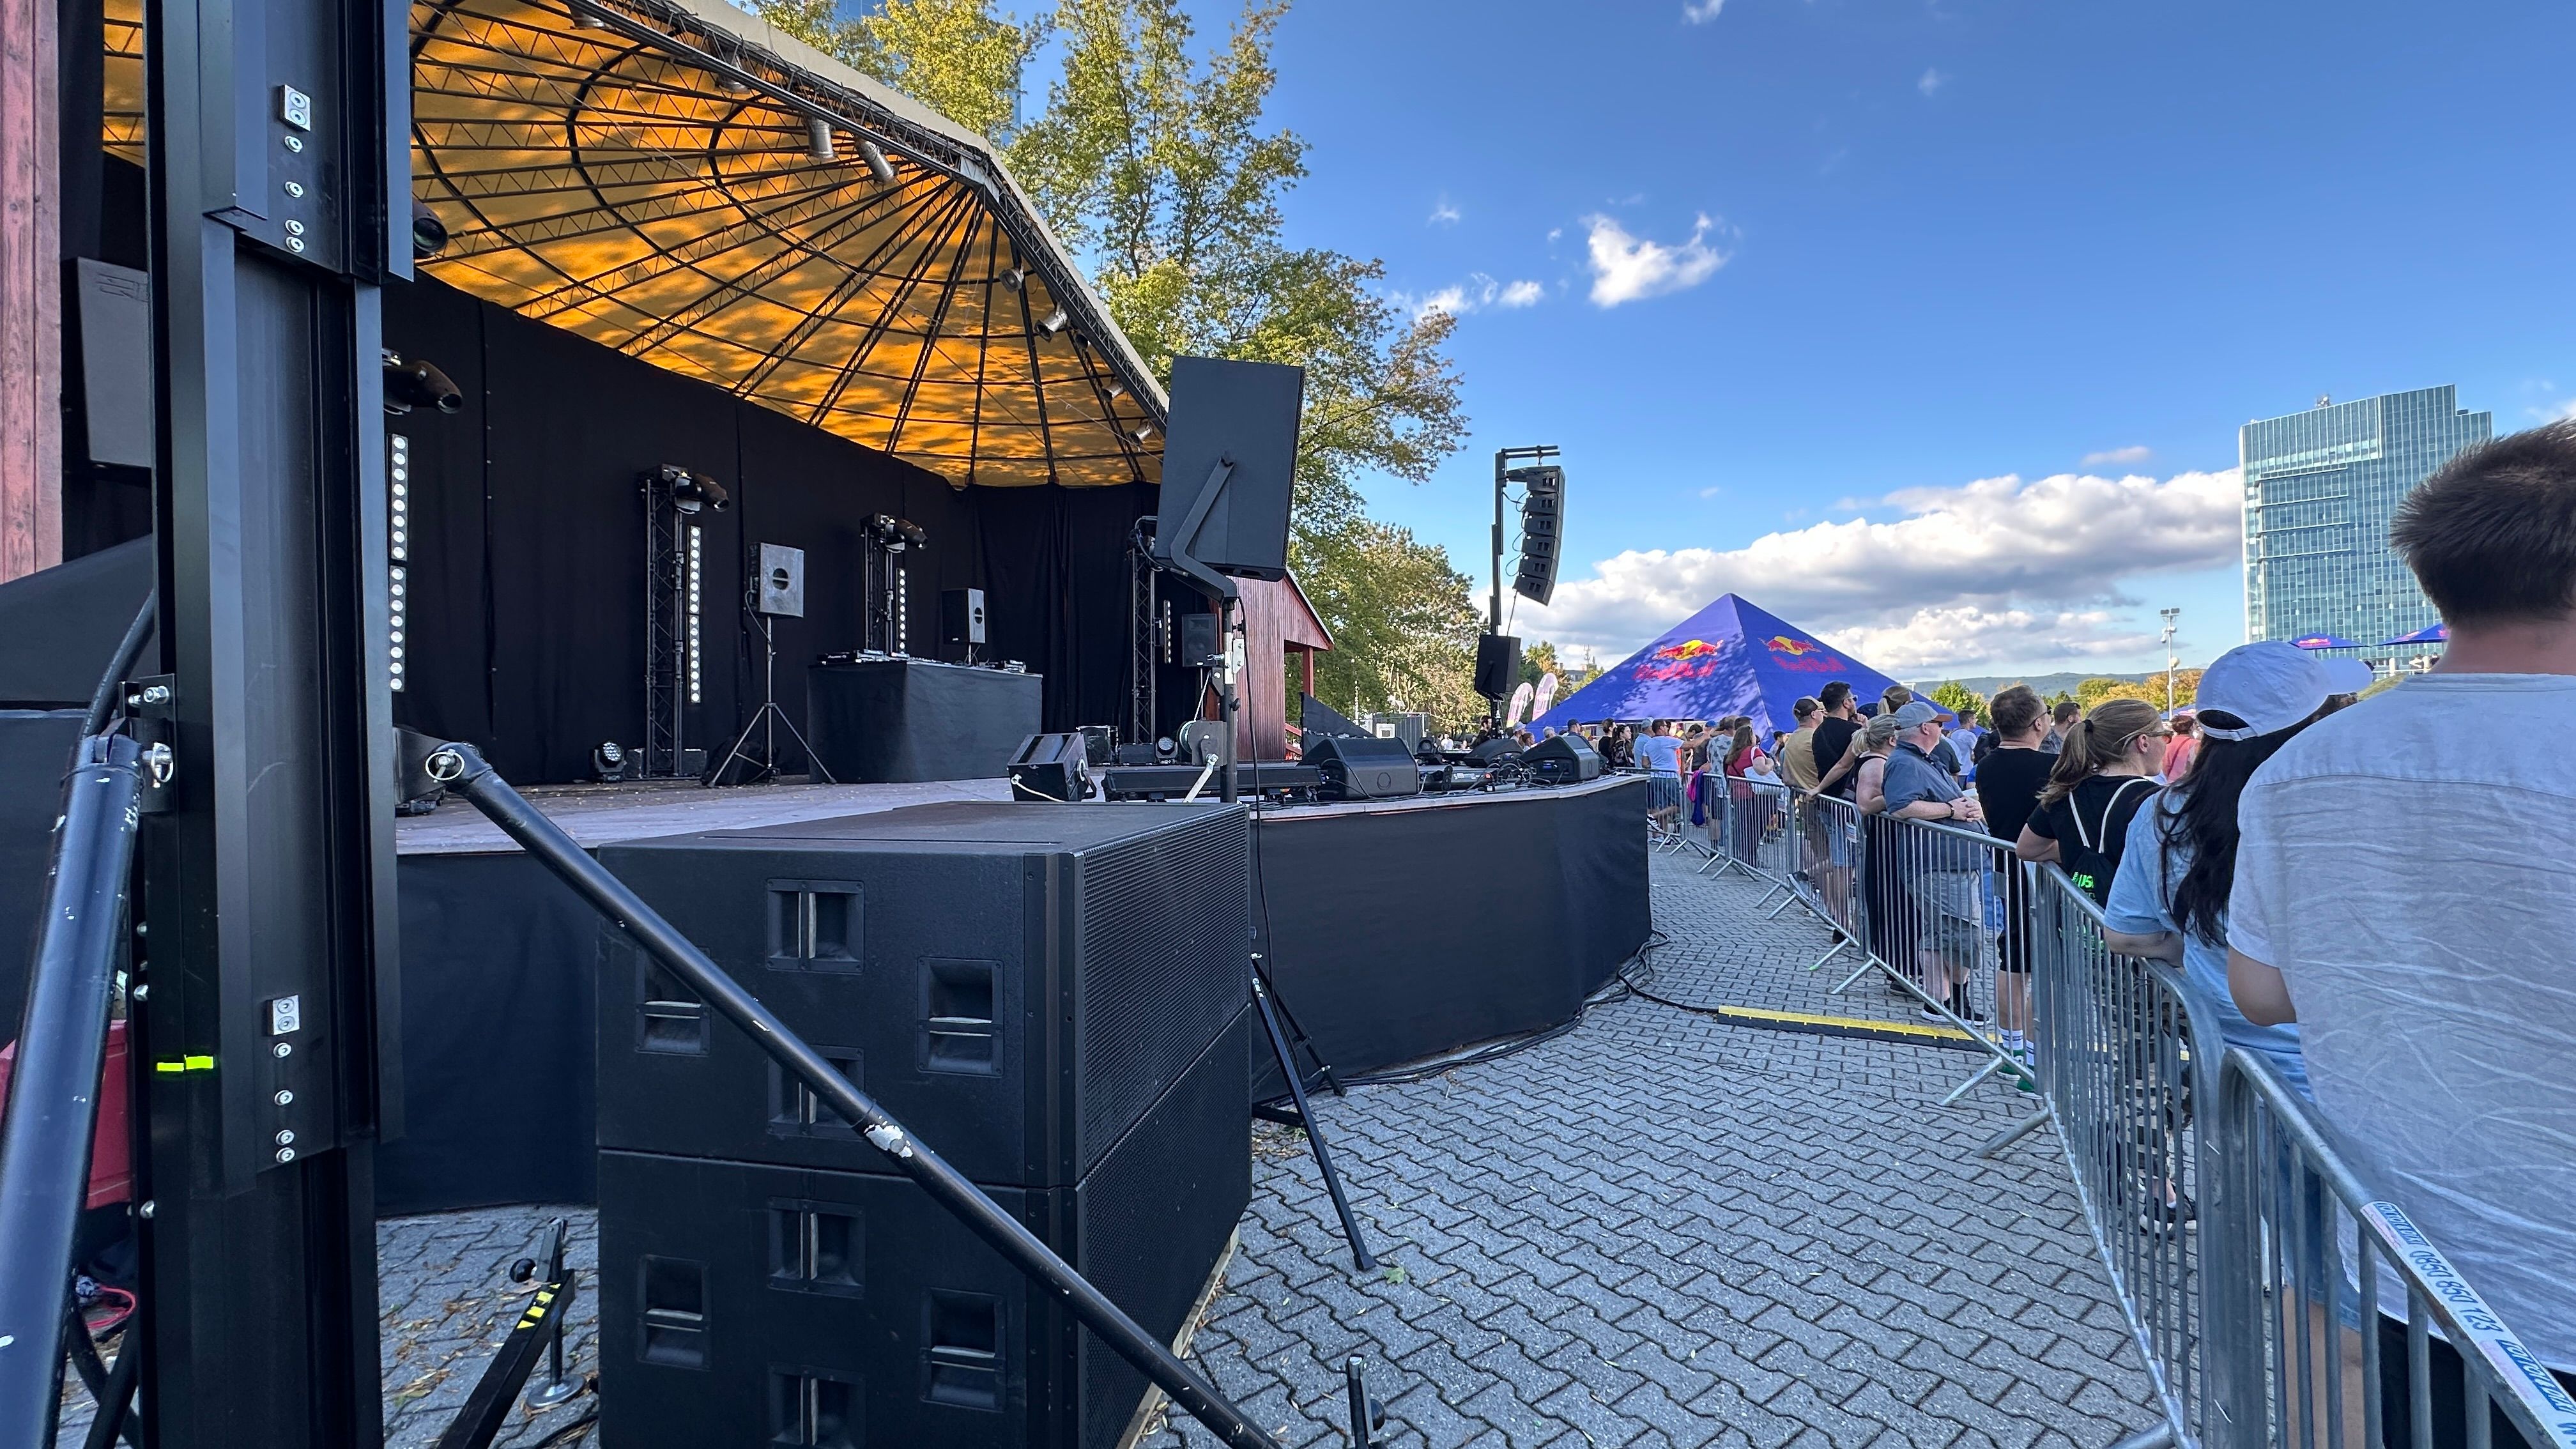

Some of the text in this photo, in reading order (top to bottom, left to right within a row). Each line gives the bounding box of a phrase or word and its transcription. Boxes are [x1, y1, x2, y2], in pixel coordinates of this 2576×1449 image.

[2409, 1250, 2454, 1277] 0850
[2436, 1280, 2478, 1303] 850
[2460, 1308, 2504, 1332] 123
